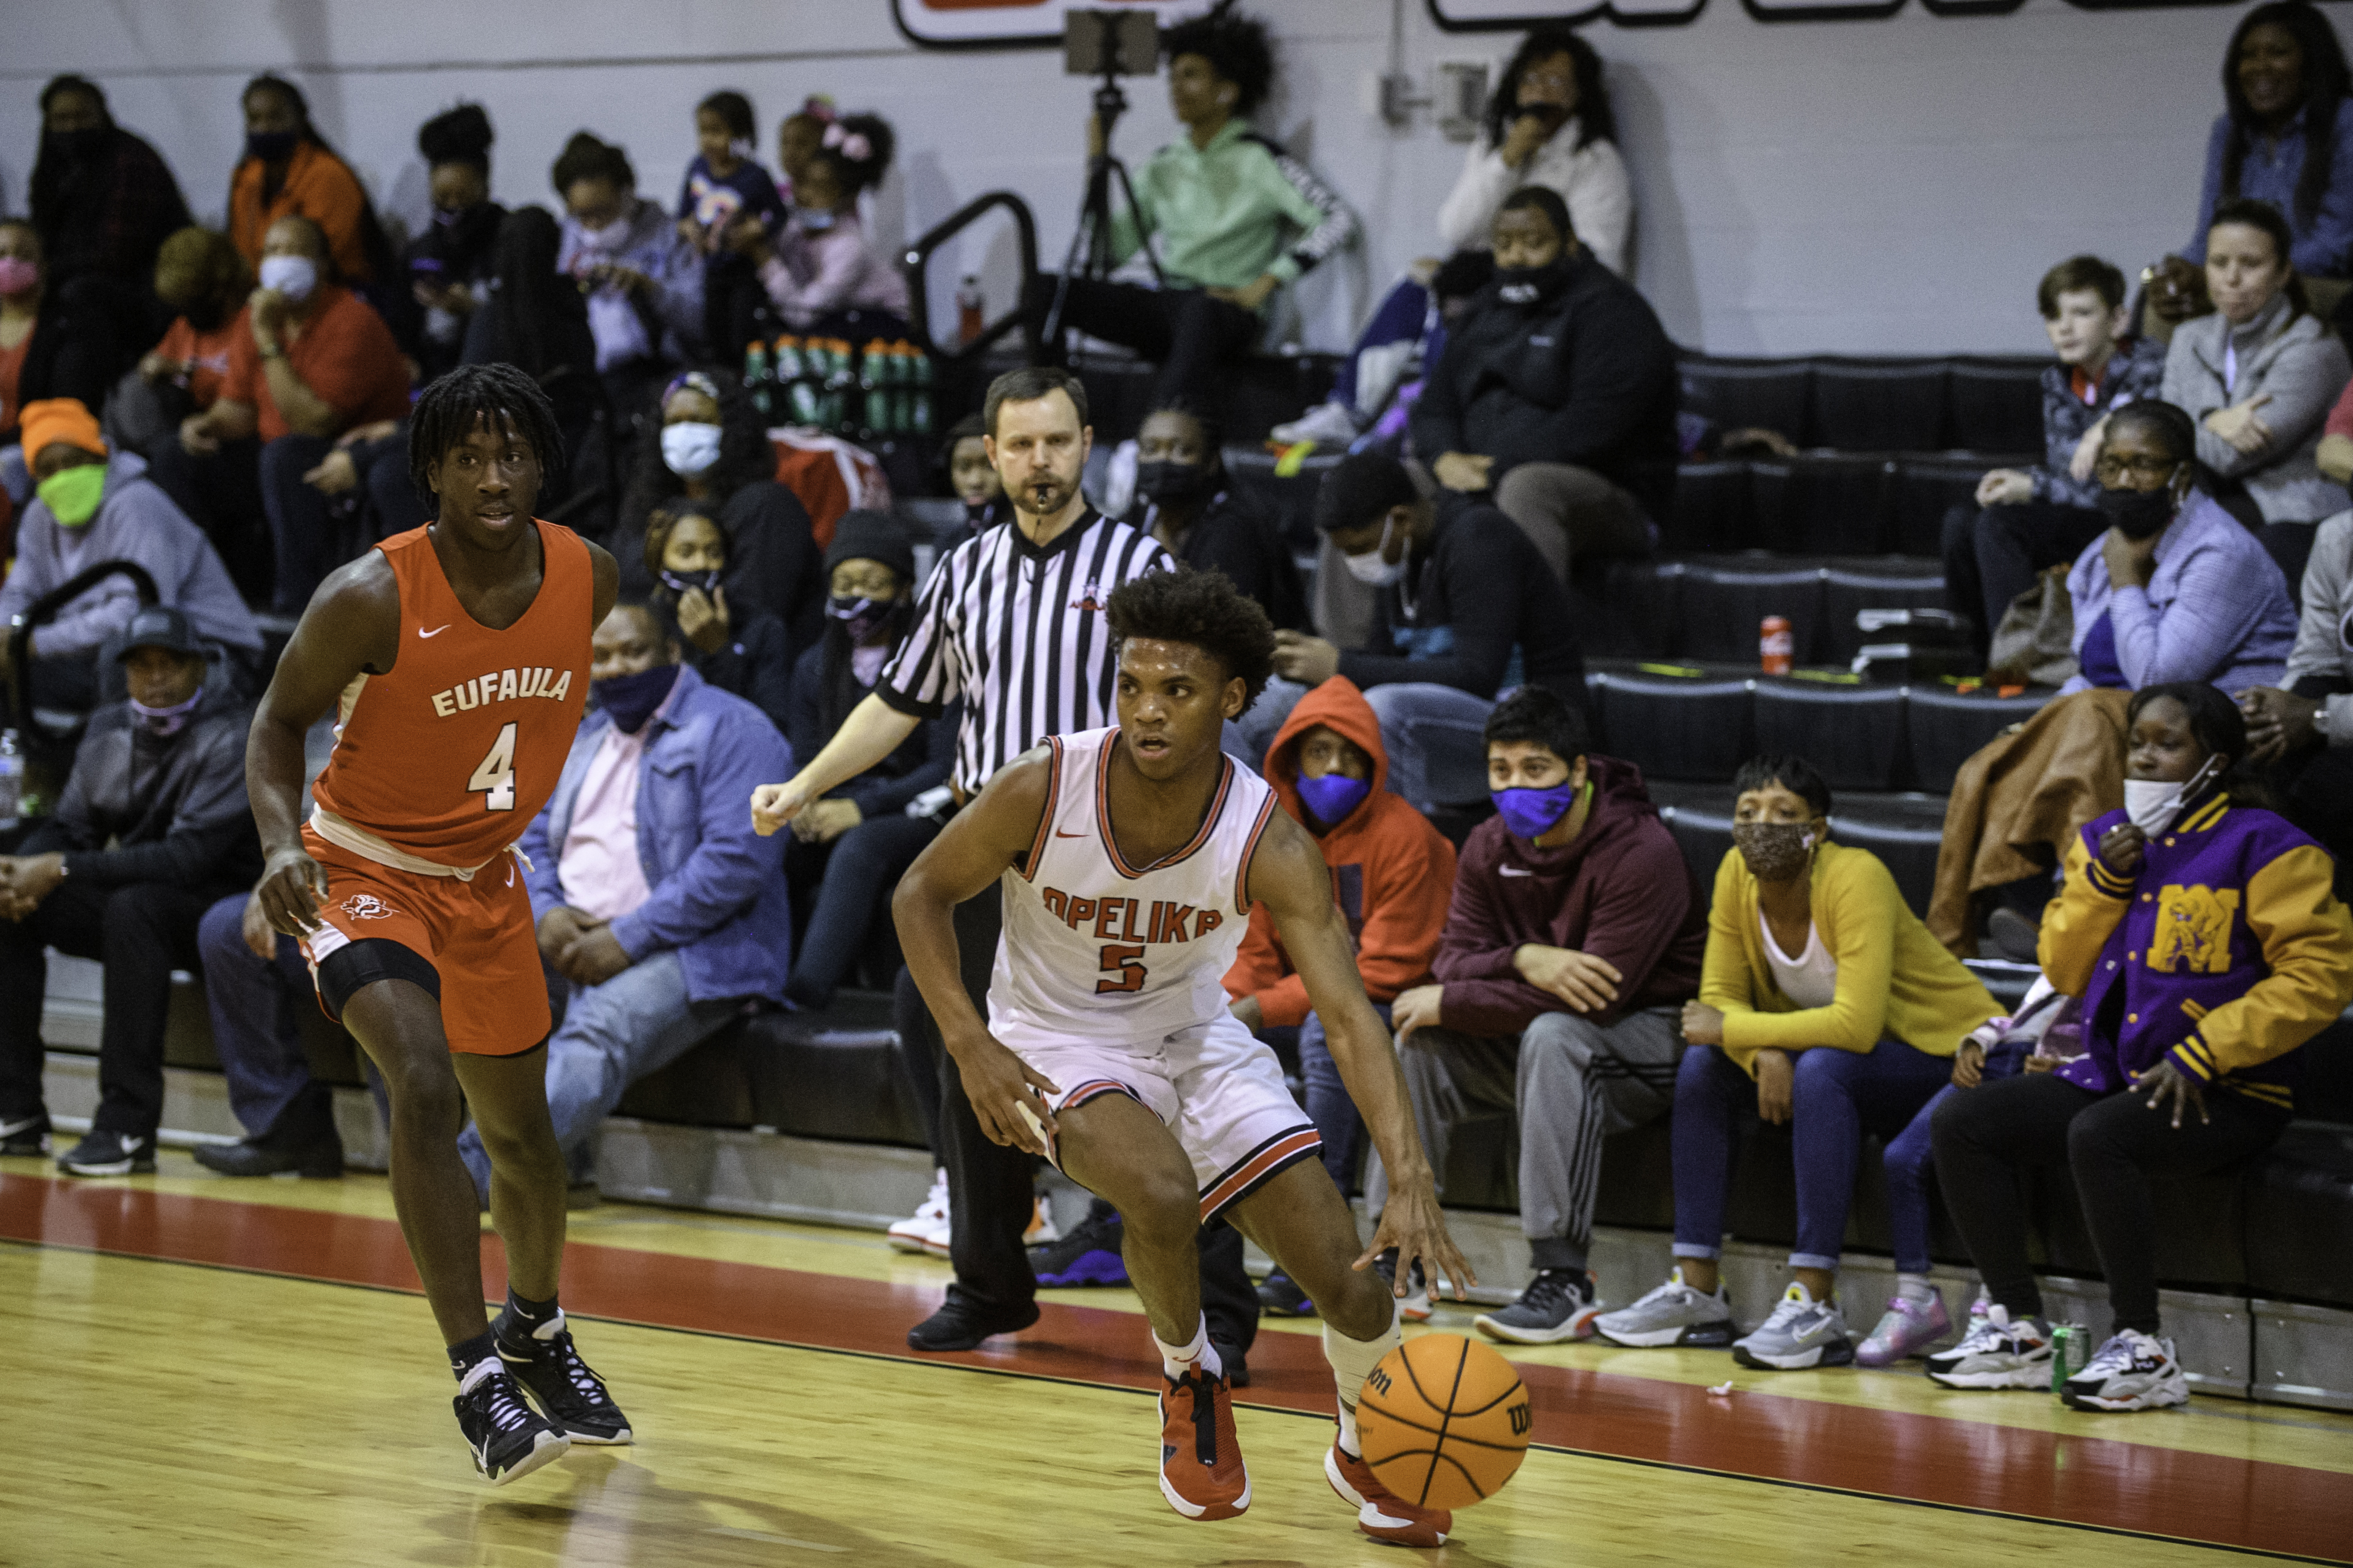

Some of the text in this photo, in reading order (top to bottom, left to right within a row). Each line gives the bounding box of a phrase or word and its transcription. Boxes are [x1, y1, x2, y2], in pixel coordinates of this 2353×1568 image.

[430, 666, 573, 718] EUFAULA
[466, 720, 519, 812] 4
[1095, 944, 1148, 995] 5
